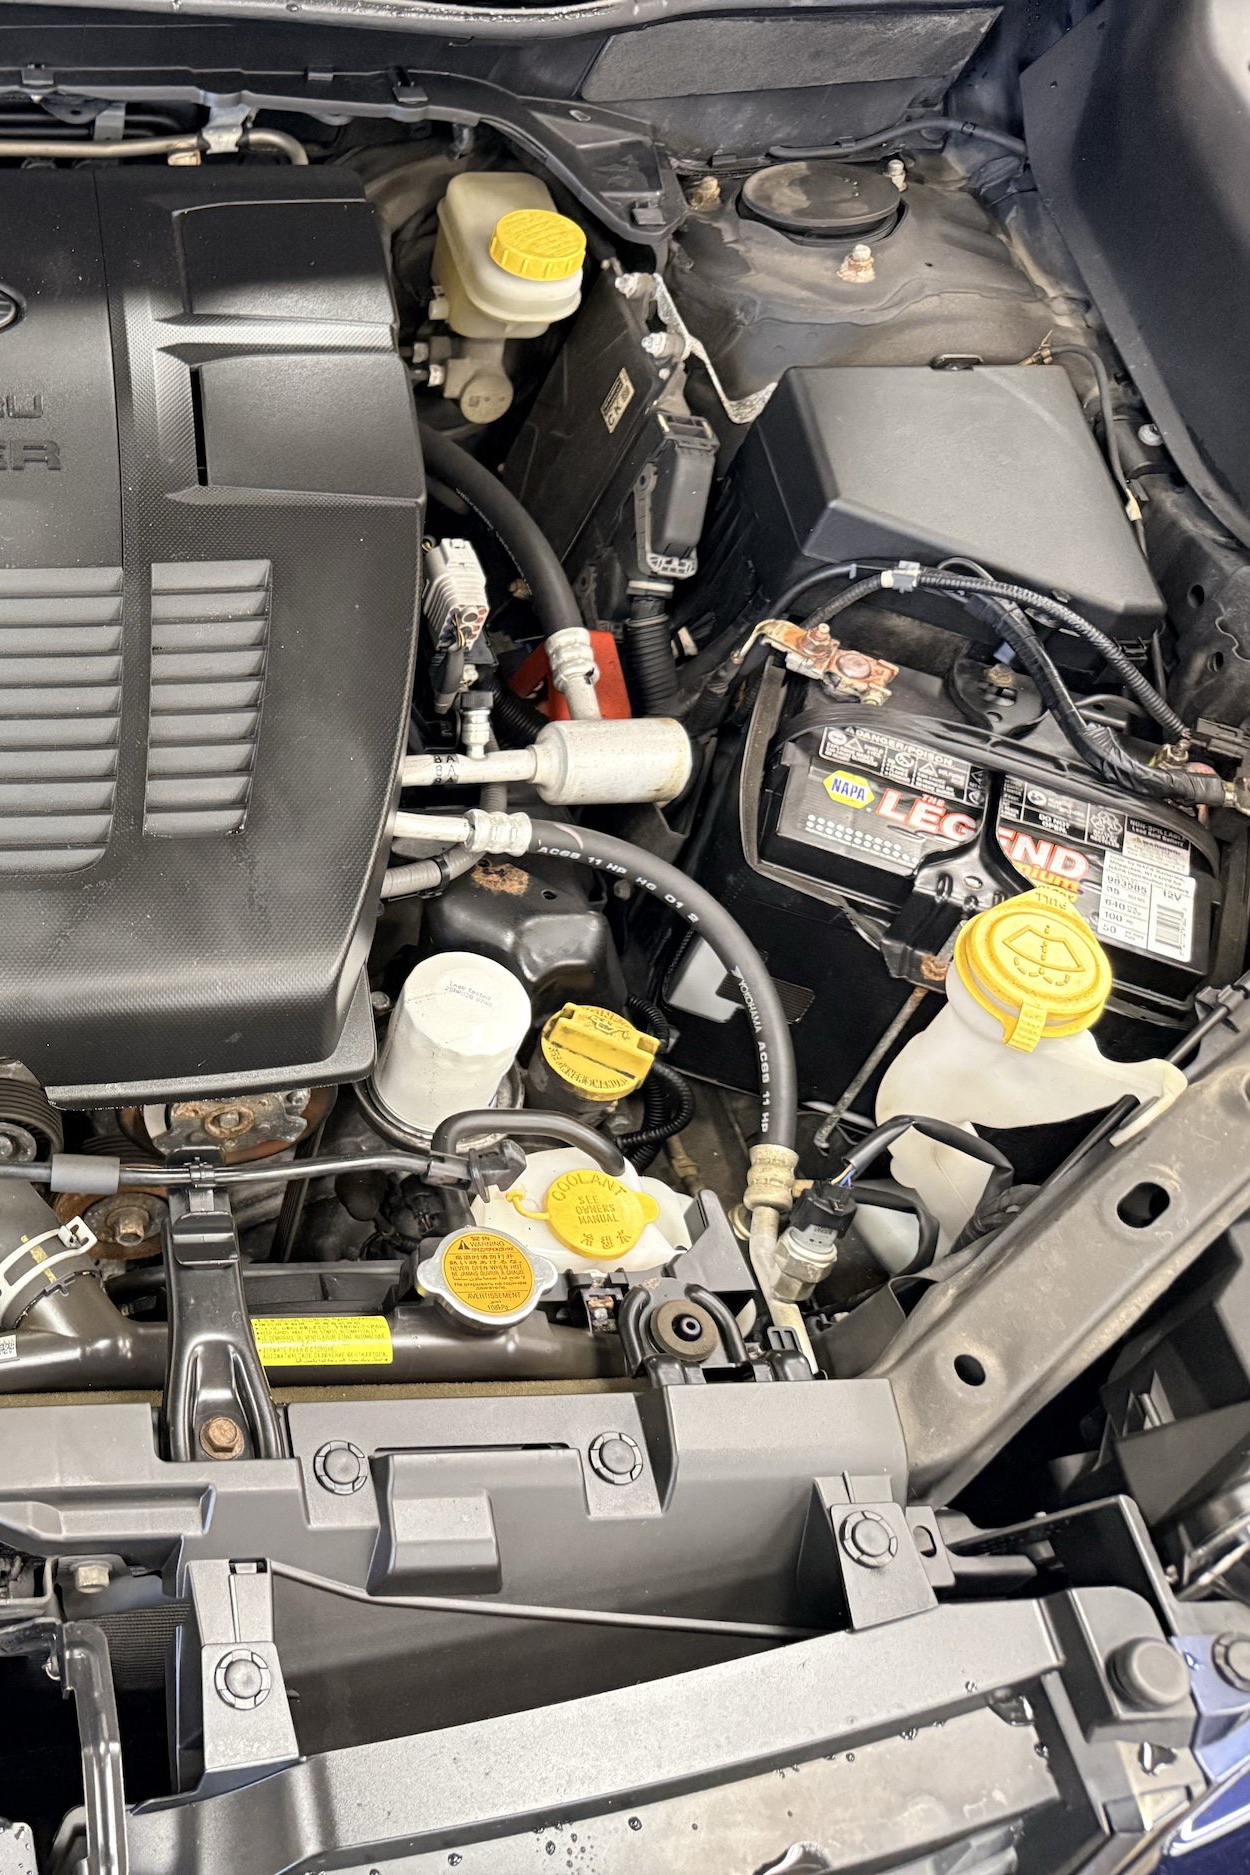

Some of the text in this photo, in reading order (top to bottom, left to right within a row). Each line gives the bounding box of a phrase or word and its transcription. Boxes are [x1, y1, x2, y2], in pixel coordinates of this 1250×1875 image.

[854, 728, 954, 766] DANGER/POISON
[831, 777, 866, 802] NAPA
[606, 863, 628, 875] HP
[1162, 888, 1183, 902] 12V
[1105, 898, 1126, 911] 640
[1104, 910, 1124, 922] 100
[1102, 923, 1117, 935] 50
[737, 978, 763, 1034] YOKOHAMA
[760, 1111, 770, 1133] HP
[551, 1172, 628, 1202] COOLANT
[578, 1194, 600, 1205] SEE
[575, 1203, 616, 1216] OWNERS
[577, 1212, 620, 1225] MANUAL
[467, 1292, 521, 1300] AVERTISSEMENT
